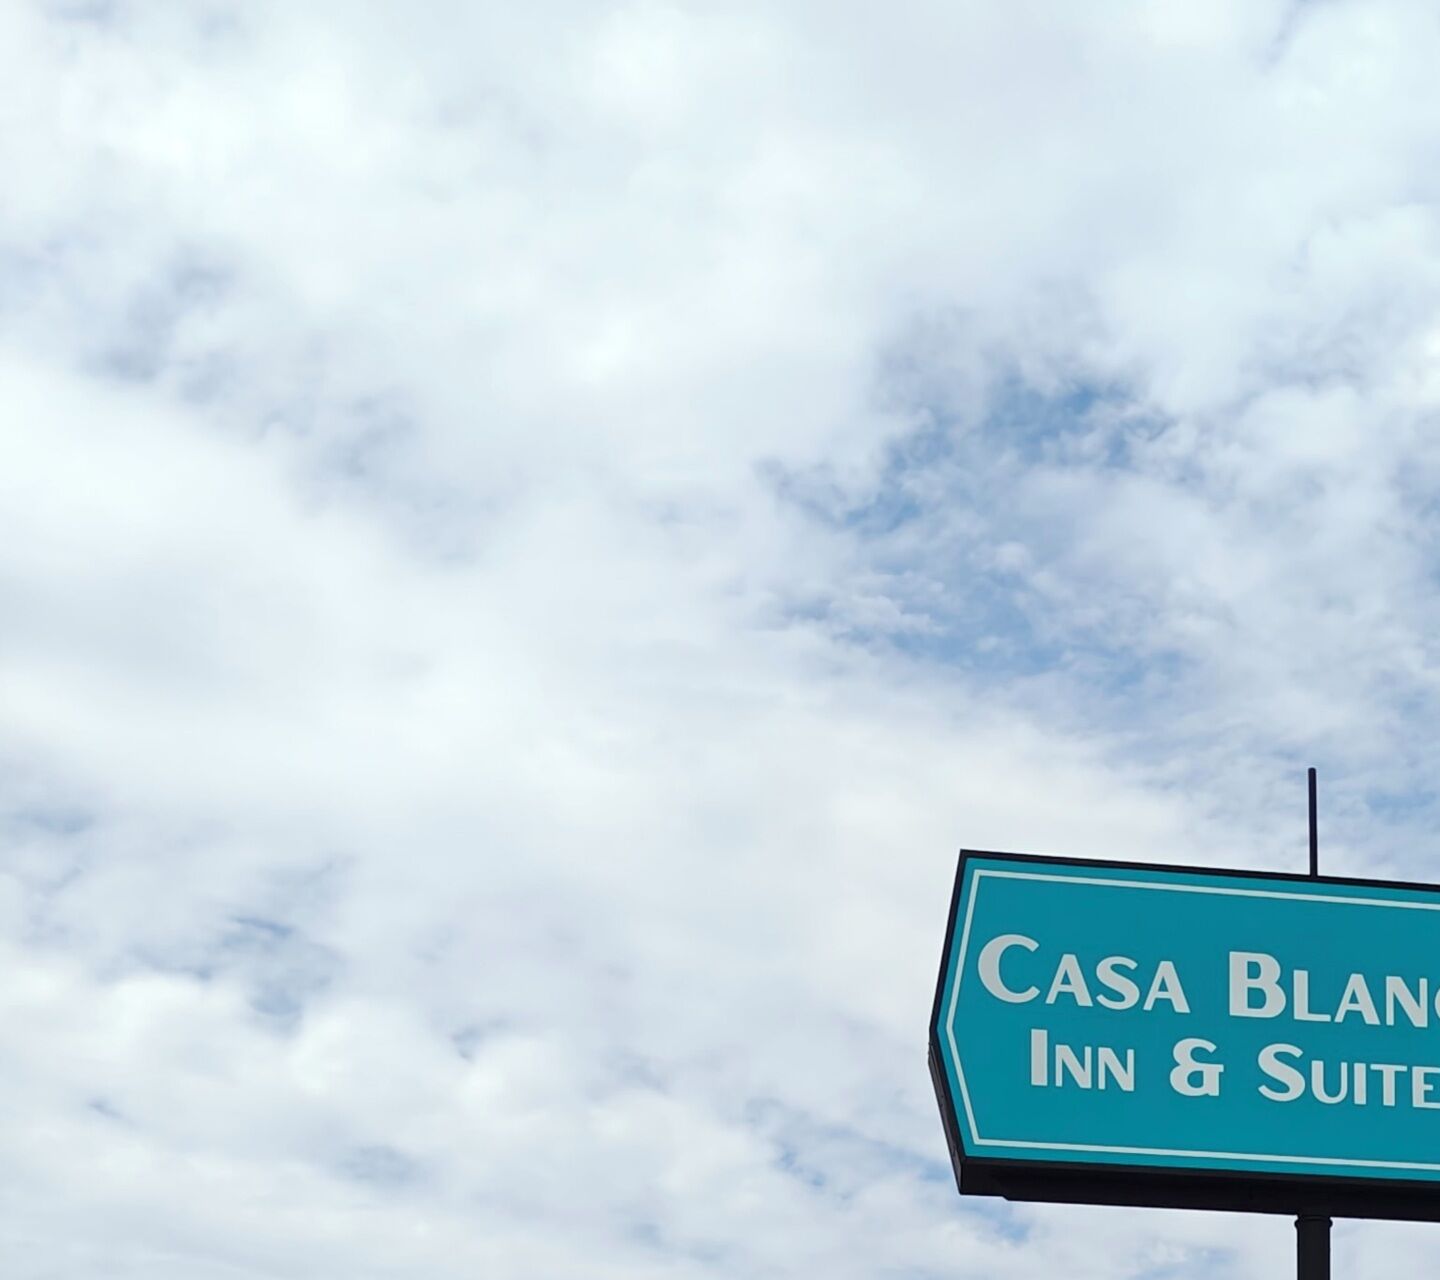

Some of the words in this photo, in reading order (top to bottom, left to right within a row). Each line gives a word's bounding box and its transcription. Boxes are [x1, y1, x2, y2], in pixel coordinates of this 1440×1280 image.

[978, 934, 1190, 1013] CASA
[1031, 1029, 1135, 1092] INN
[1169, 1038, 1224, 1097] &
